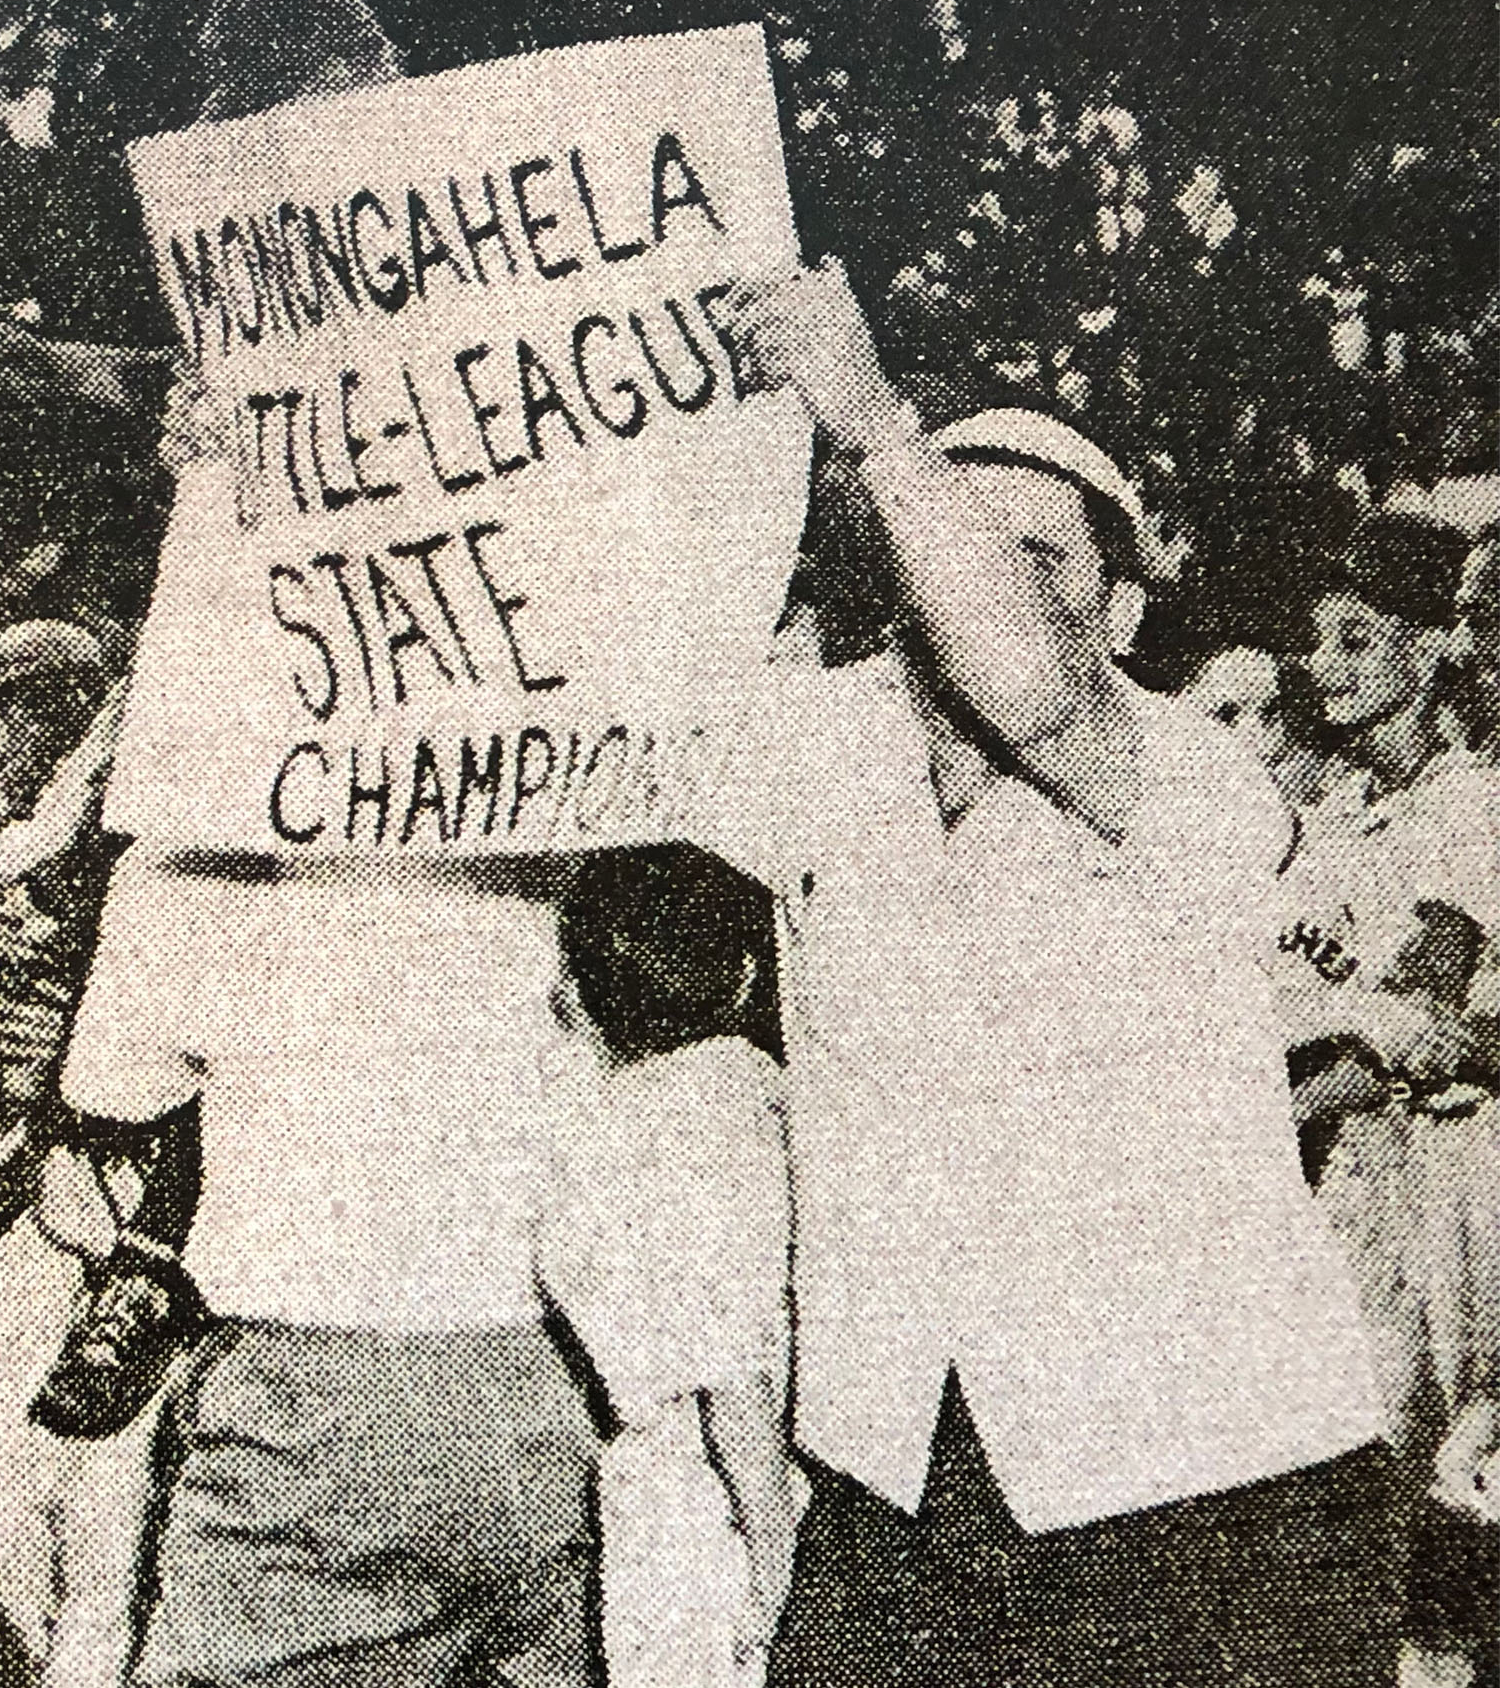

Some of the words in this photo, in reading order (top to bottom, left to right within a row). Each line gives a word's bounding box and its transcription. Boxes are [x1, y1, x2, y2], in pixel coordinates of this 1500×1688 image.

[170, 131, 728, 357] MONONGAHELA
[269, 522, 566, 721] STATE
[269, 727, 703, 845] CHAMPIO
